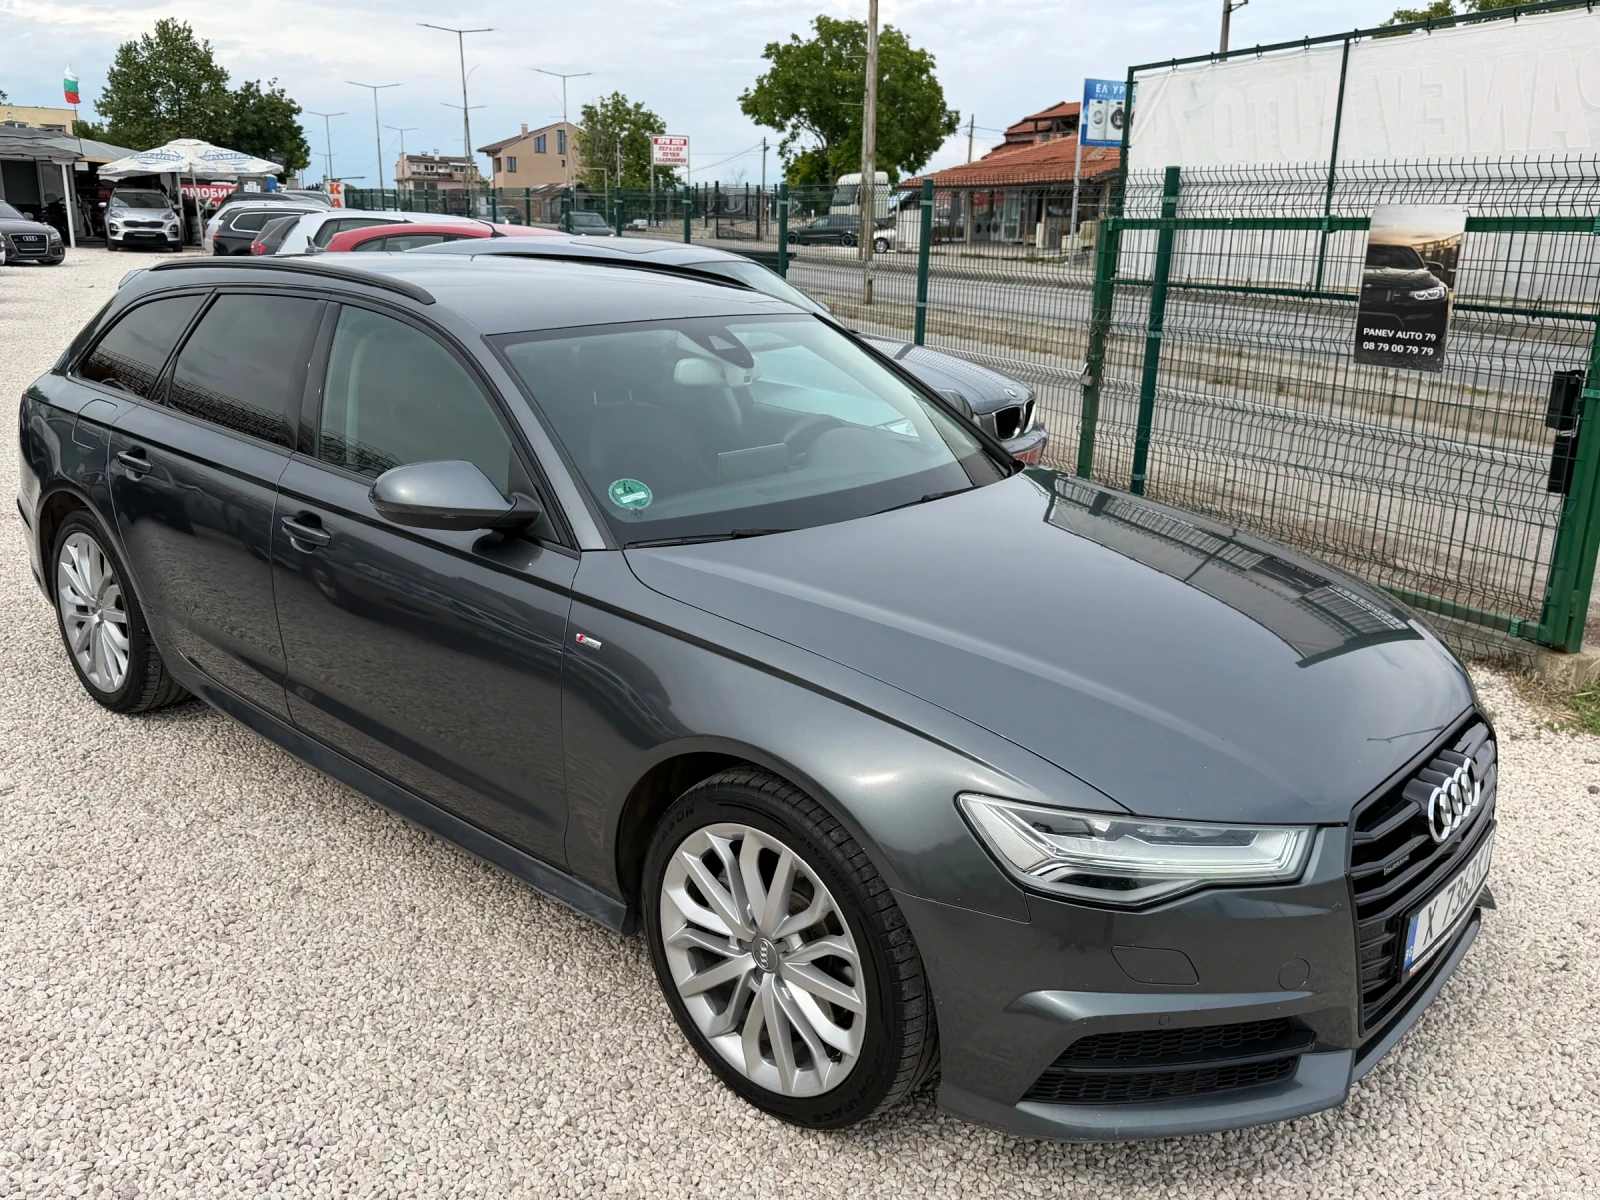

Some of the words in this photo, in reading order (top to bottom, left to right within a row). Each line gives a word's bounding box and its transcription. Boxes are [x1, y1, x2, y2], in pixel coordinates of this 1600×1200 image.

[1095, 84, 1108, 94] ЕЛ
[1363, 327, 1395, 338] PANEV
[1396, 330, 1423, 341] AUTO
[1425, 332, 1437, 342] 79
[1362, 341, 1375, 351] 08
[1377, 342, 1390, 352] 79
[1391, 343, 1404, 353] 00
[1406, 345, 1419, 355] 79
[1421, 346, 1434, 356] 79
[1422, 899, 1439, 947] X
